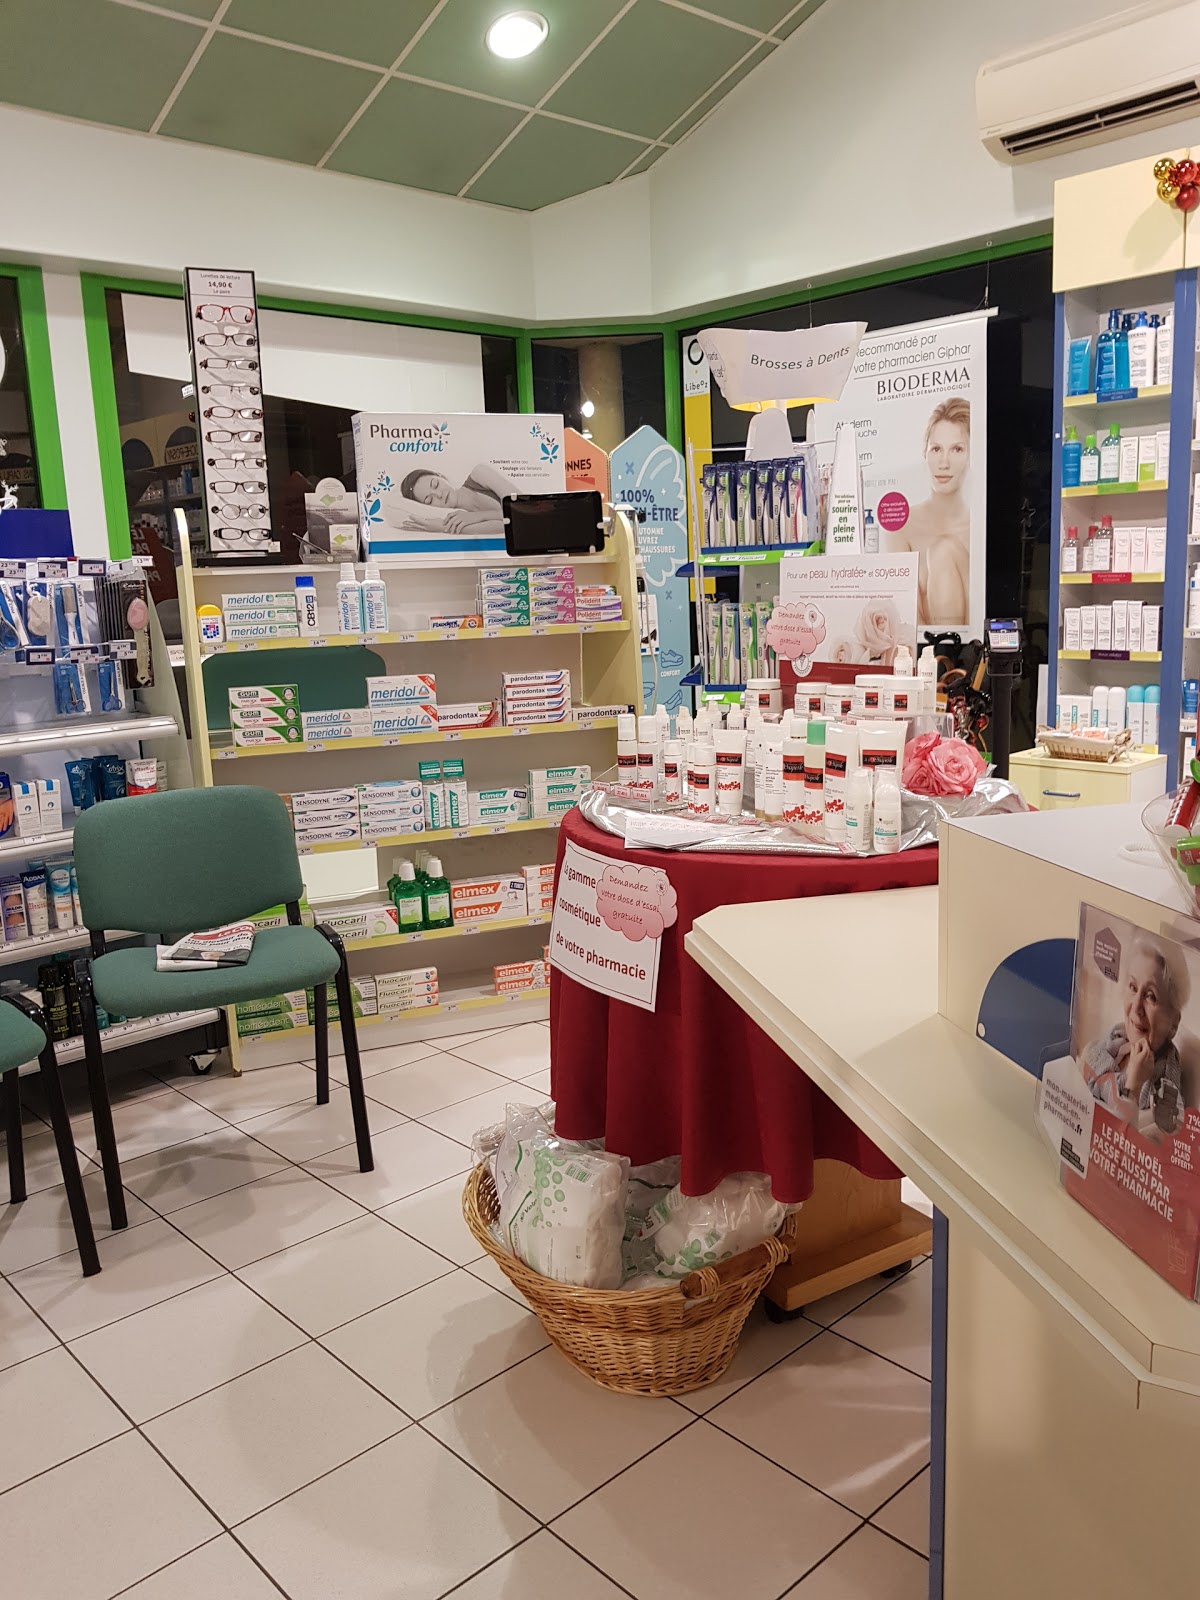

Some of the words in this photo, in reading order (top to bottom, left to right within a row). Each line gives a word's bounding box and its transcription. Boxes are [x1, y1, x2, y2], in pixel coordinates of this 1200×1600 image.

[921, 334, 937, 347] par
[750, 354, 802, 370] Brosses
[806, 357, 813, 368] à
[817, 346, 849, 365] Dents
[854, 361, 876, 373] votre
[879, 351, 934, 372] pharmacien
[937, 344, 971, 360] Giphar
[877, 367, 970, 395] BIODERMA
[877, 392, 914, 402] LABORATOIRE
[917, 382, 971, 396] DERMATOLOGIQUE
[370, 424, 432, 439] Pharma
[389, 440, 444, 454] confort
[566, 459, 592, 471] NNES
[620, 489, 655, 503] 100%
[832, 505, 857, 513] sourire
[638, 528, 664, 536] UTOMNE
[833, 523, 856, 535] pleine
[834, 534, 854, 543] santé
[486, 572, 510, 580] Fixodent
[532, 570, 557, 579] Fixodent
[809, 569, 829, 580] peau
[874, 567, 910, 580] soyeuse
[487, 586, 511, 595] Fixodent
[533, 583, 558, 593] Fixodent
[227, 594, 264, 605] meridol
[534, 599, 559, 608] Fixodent
[576, 597, 601, 605] Polident
[487, 601, 512, 610] Fixodent
[229, 611, 266, 621] meridol
[307, 603, 316, 627] CB12
[487, 616, 512, 625] Fixodent
[534, 613, 559, 622] Fixodent
[778, 611, 805, 619] Demandez
[231, 626, 267, 636] meridol
[783, 624, 796, 632] dose
[779, 638, 801, 646] gratuite
[510, 674, 544, 683] parodontax
[661, 669, 681, 678] CONFORT
[371, 685, 417, 699] meridol
[511, 687, 545, 696] parodontax
[512, 700, 546, 709] parodontax
[306, 712, 341, 723] meridol
[437, 712, 478, 722] parodontax
[512, 713, 547, 723] parodontax
[577, 707, 622, 719] parodontax
[373, 715, 419, 729] meridol
[308, 727, 342, 738] meridol
[548, 770, 573, 778] elmex
[361, 791, 395, 799] SENSODYNE
[480, 791, 506, 800] elmex
[548, 786, 573, 794] elmex
[296, 798, 331, 806] SENSODYNE
[549, 802, 574, 811] elmex
[363, 808, 397, 816] SENSODYNE
[481, 807, 506, 816] elmex
[298, 815, 332, 824] SENSODYNE
[364, 826, 398, 834] SENSODYNE
[298, 832, 333, 841] SENSODYNE
[568, 867, 596, 889] gamme
[609, 875, 649, 893] Demandez
[454, 886, 495, 899] elmex
[601, 889, 616, 901] votre
[617, 895, 634, 906] dose
[636, 899, 660, 913] d'essai
[456, 906, 496, 918] elmex
[559, 897, 601, 928] cosmétique
[612, 910, 643, 925] gratuite
[556, 931, 564, 947] de
[564, 941, 585, 958] votre
[586, 949, 646, 980] pharmacie
[500, 965, 531, 977] elmex
[377, 975, 412, 985] Fluocaril
[500, 978, 531, 990] elmex
[379, 988, 413, 998] Fluocaril
[237, 1000, 288, 1014] homéodent
[379, 1000, 413, 1010] Fluocaril
[238, 1017, 289, 1031] homéodent
[1046, 1079, 1090, 1115] mon-materiel-
[1044, 1090, 1081, 1120] medical-en-
[1043, 1101, 1083, 1136] pharmacie.fr
[1102, 1123, 1112, 1137] LE
[1113, 1131, 1136, 1157] PÈRE
[1137, 1150, 1164, 1180] NOËL
[1173, 1138, 1191, 1154] VOTRE
[1174, 1147, 1191, 1162] PLAID
[1093, 1133, 1119, 1164] PASSE
[1121, 1153, 1150, 1183] AUSSI
[1150, 1175, 1170, 1203] PAR
[1089, 1148, 1116, 1178] VOTRE
[1117, 1169, 1174, 1223] PHARMACIE
